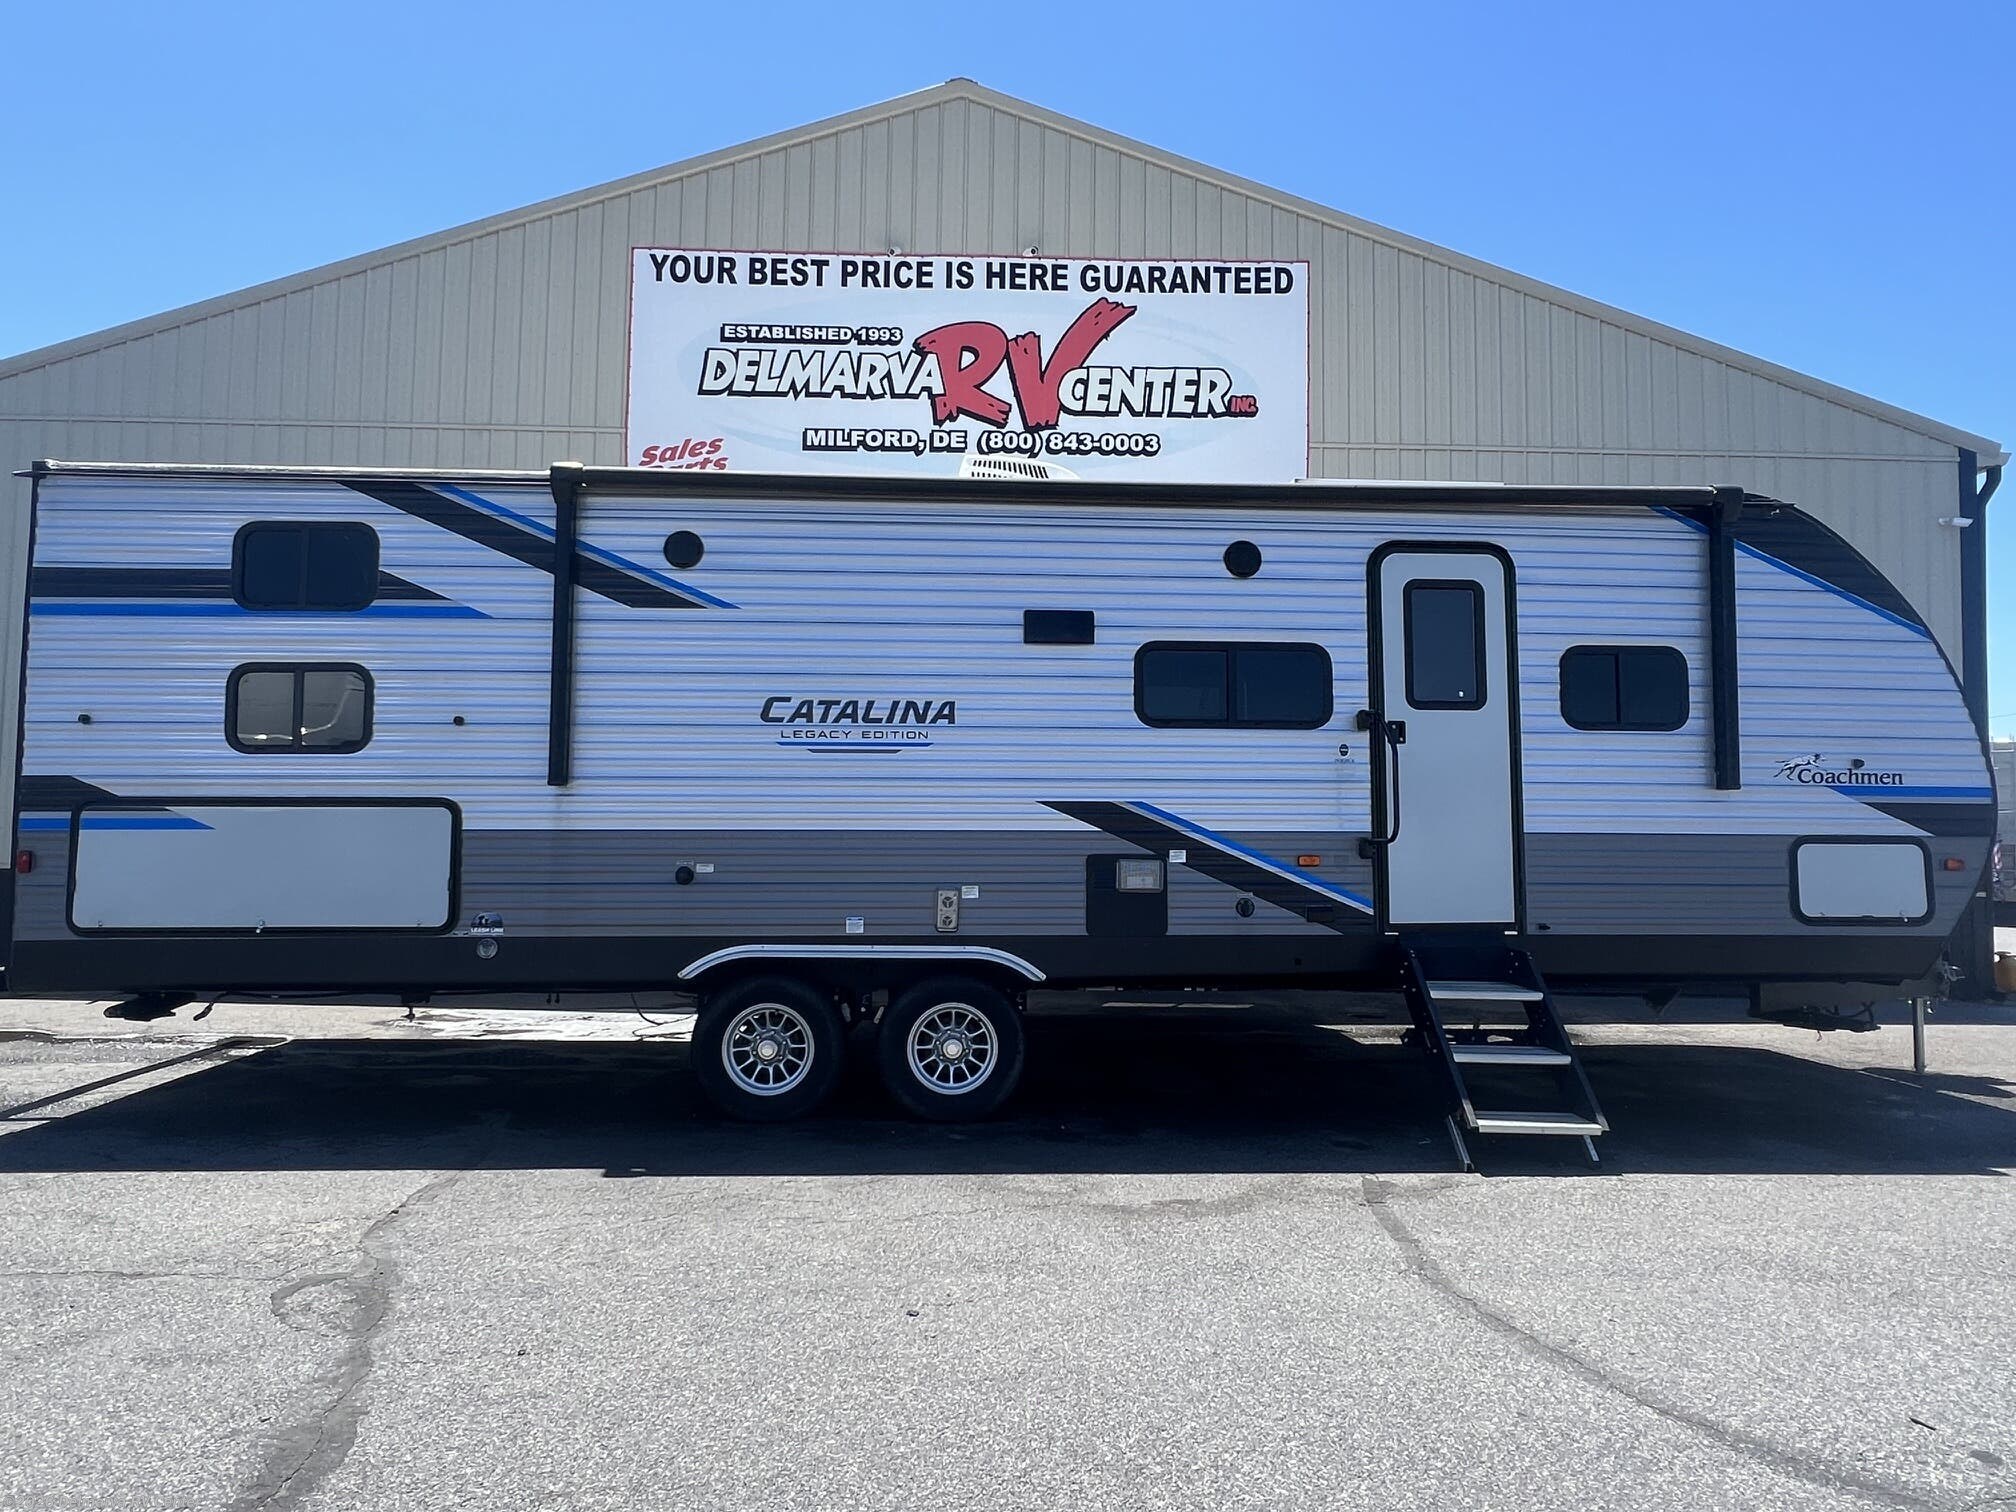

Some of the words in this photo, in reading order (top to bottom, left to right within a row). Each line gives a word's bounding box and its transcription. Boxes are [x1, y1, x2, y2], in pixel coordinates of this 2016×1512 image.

[649, 253, 737, 285] YOUR
[749, 256, 830, 287] BEST
[841, 259, 934, 289] PRICE
[946, 261, 975, 290] IS
[986, 261, 1069, 292] HERE
[1080, 264, 1294, 294] GUARANTEED
[721, 324, 853, 344] ESTABLISHED
[856, 327, 904, 344] 1993
[699, 348, 946, 400] DELMARVA
[914, 297, 1138, 430] RV
[1057, 366, 1233, 418] CENTER
[802, 428, 926, 455] MILFORD,
[929, 431, 967, 452] DE
[977, 431, 1042, 457] (800)
[1046, 433, 1161, 455] 843-0003
[760, 696, 956, 725] CATALINA
[780, 730, 852, 738] LEGACY
[861, 731, 929, 739] EDITION
[1797, 768, 1904, 785] Coachmen
